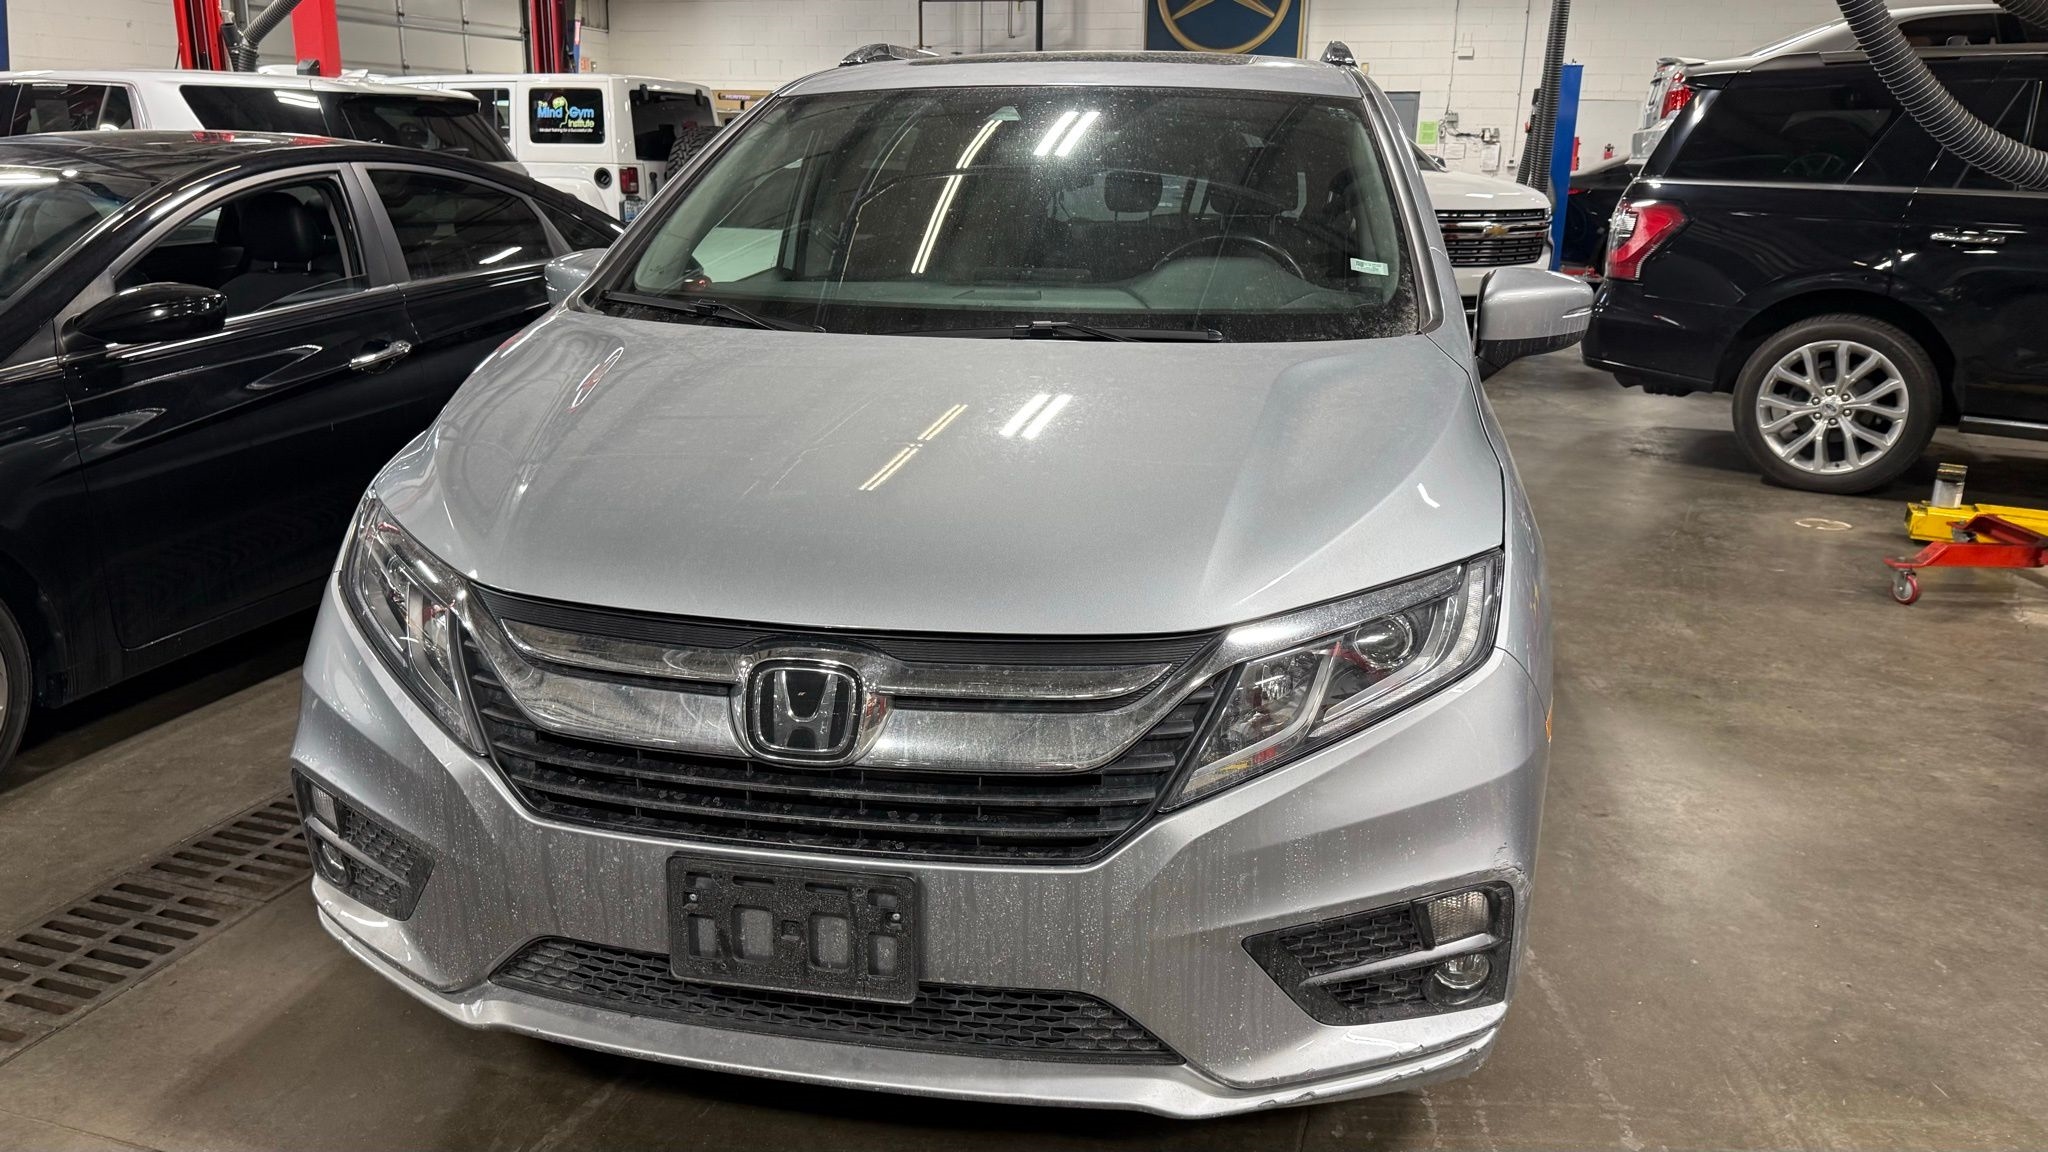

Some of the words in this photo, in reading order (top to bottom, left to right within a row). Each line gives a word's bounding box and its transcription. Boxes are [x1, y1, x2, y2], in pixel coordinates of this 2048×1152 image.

[537, 106, 563, 118] Mind
[569, 106, 595, 120] Gym
[568, 119, 595, 127] Institute
